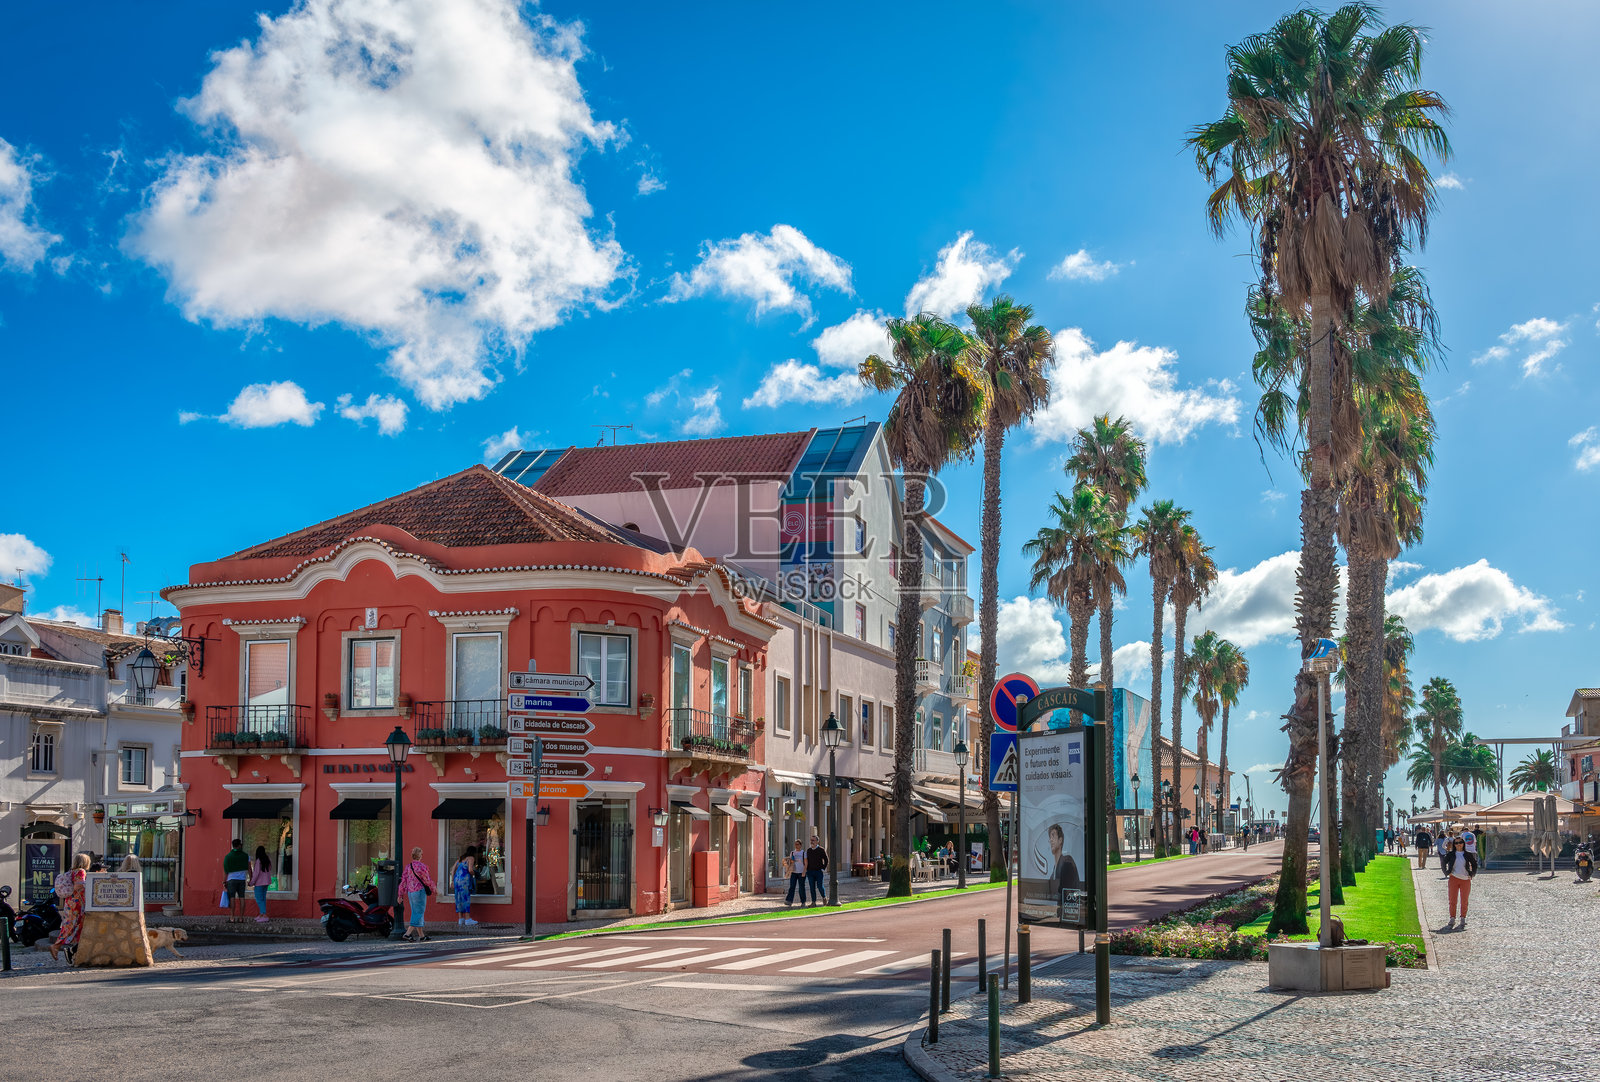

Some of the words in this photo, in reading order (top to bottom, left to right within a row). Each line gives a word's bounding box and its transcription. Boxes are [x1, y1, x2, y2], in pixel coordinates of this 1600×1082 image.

[552, 678, 585, 687] municipal
[525, 698, 553, 707] marina
[1037, 692, 1078, 711] CASCAIS
[525, 720, 551, 729] cidadela
[552, 721, 560, 729] de
[561, 721, 586, 730] Cascais
[1024, 745, 1061, 758] Experimente
[1030, 759, 1047, 769] futuro
[1048, 757, 1060, 767] dos
[1025, 771, 1050, 781] cuidados
[1050, 769, 1073, 780] visuais.
